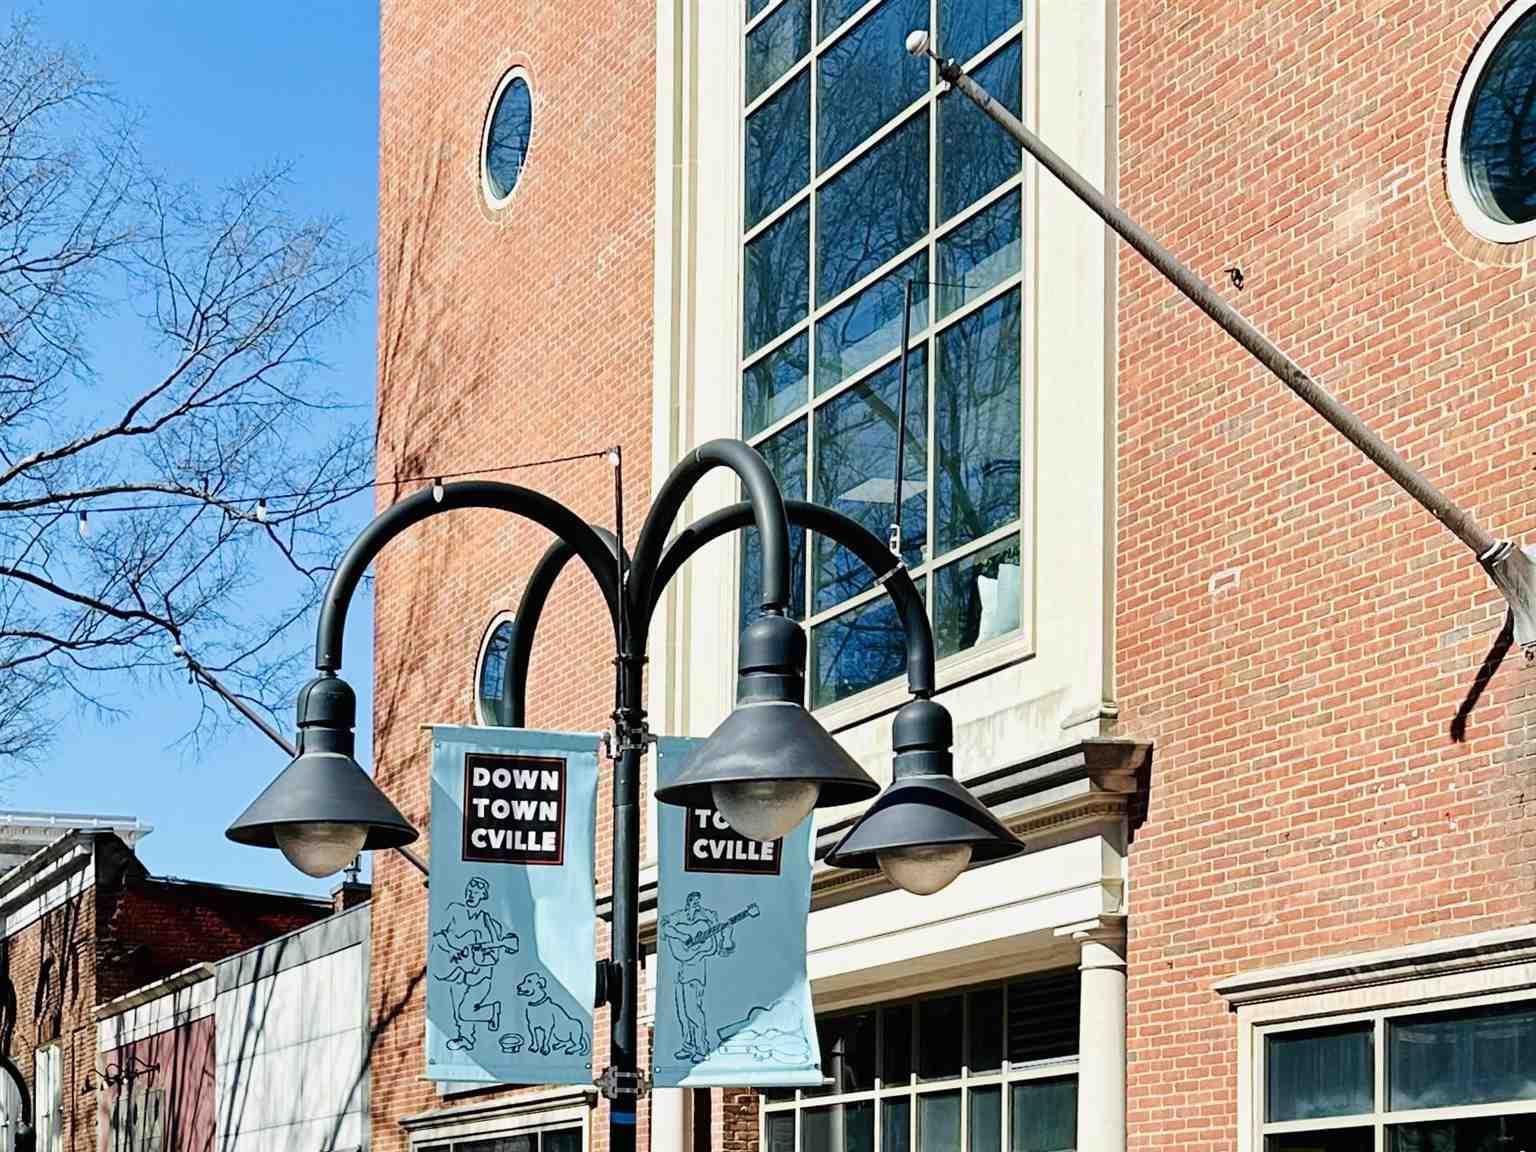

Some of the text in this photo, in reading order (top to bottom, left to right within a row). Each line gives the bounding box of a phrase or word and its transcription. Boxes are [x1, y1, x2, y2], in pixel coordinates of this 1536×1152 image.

[472, 767, 559, 791] DOWN
[472, 798, 558, 822] TOWN
[694, 808, 731, 830] TO
[471, 827, 557, 852] CVILLE
[692, 838, 775, 861] CVILLE
